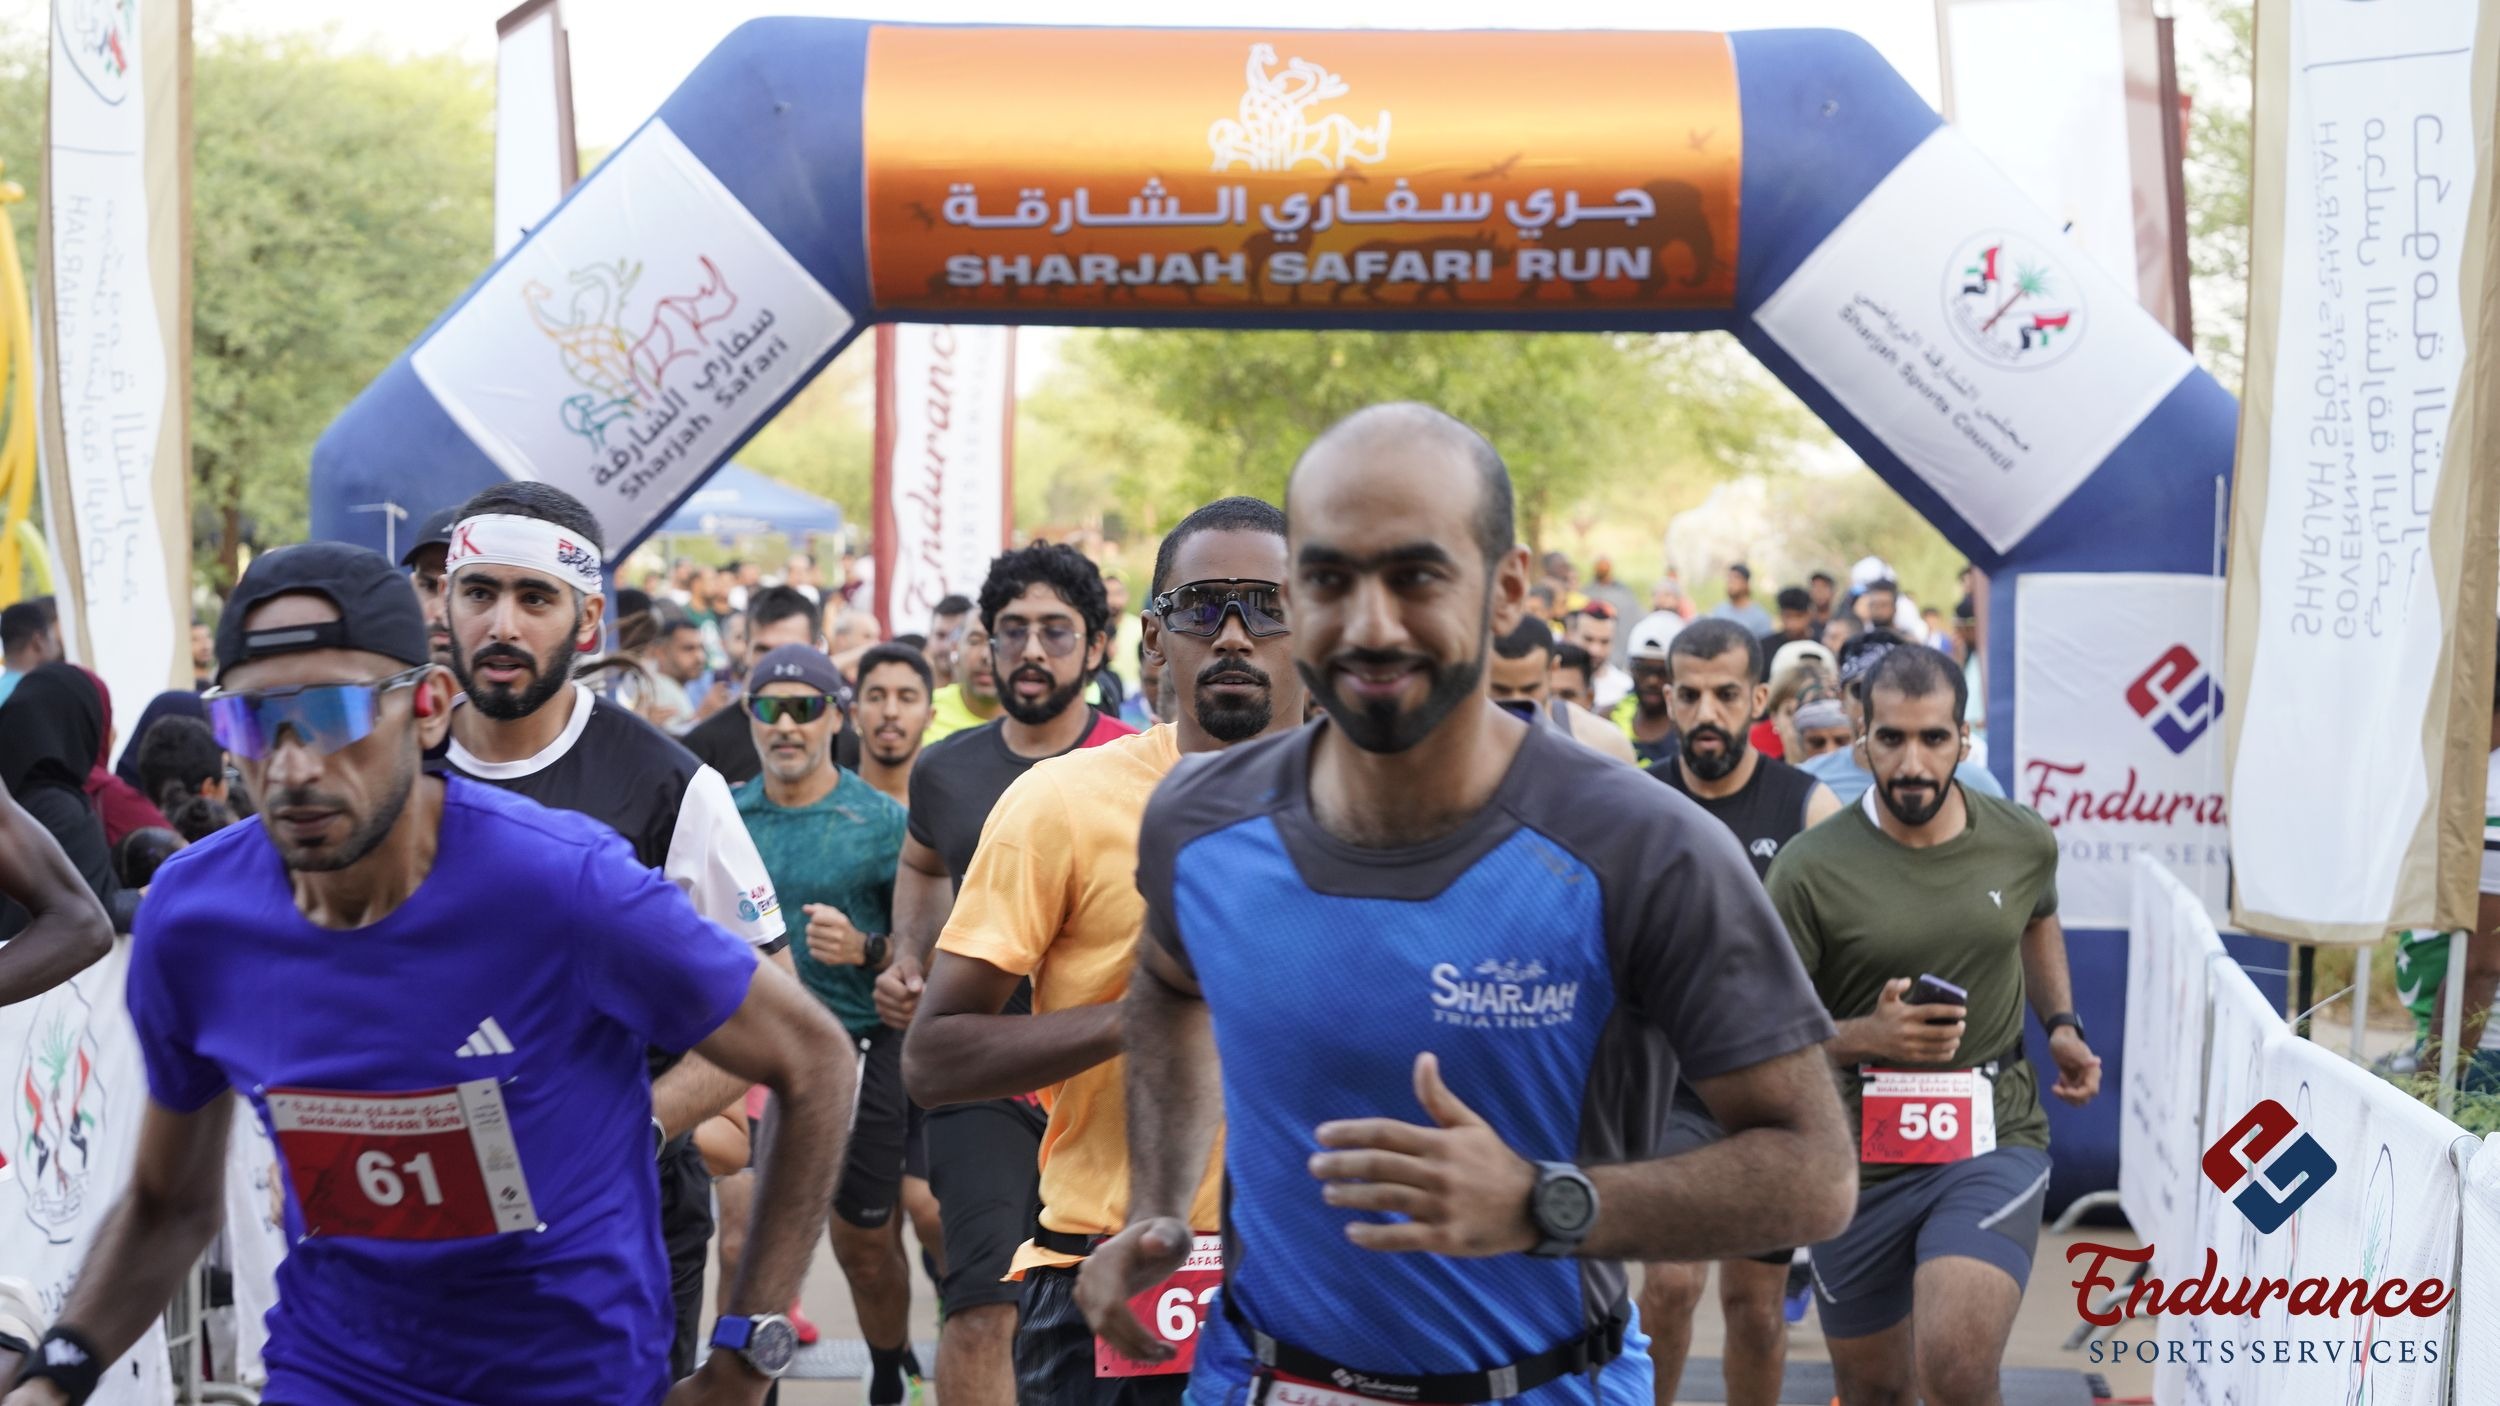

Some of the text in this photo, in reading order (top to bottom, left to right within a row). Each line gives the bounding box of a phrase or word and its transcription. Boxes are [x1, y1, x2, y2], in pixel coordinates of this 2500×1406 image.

[942, 176, 1657, 242] جري سفاري الشارقة
[944, 245, 1652, 287] SHARJAH SAFARI RUN
[590, 307, 776, 487] سفاري الشارقة
[617, 334, 790, 500] Sharjah Safari
[1838, 302, 1899, 366] Sharjah
[1898, 361, 1951, 417] Sports
[1951, 410, 2016, 474] Council
[903, 324, 957, 615] Enduranc
[2025, 759, 2227, 828] Endura
[1430, 962, 1579, 1014] SHARJAH
[1432, 1008, 1574, 1029] TRIATHLON
[1898, 1102, 1959, 1141] 56
[355, 1149, 444, 1208] 61
[1184, 1255, 1223, 1267] AFAR
